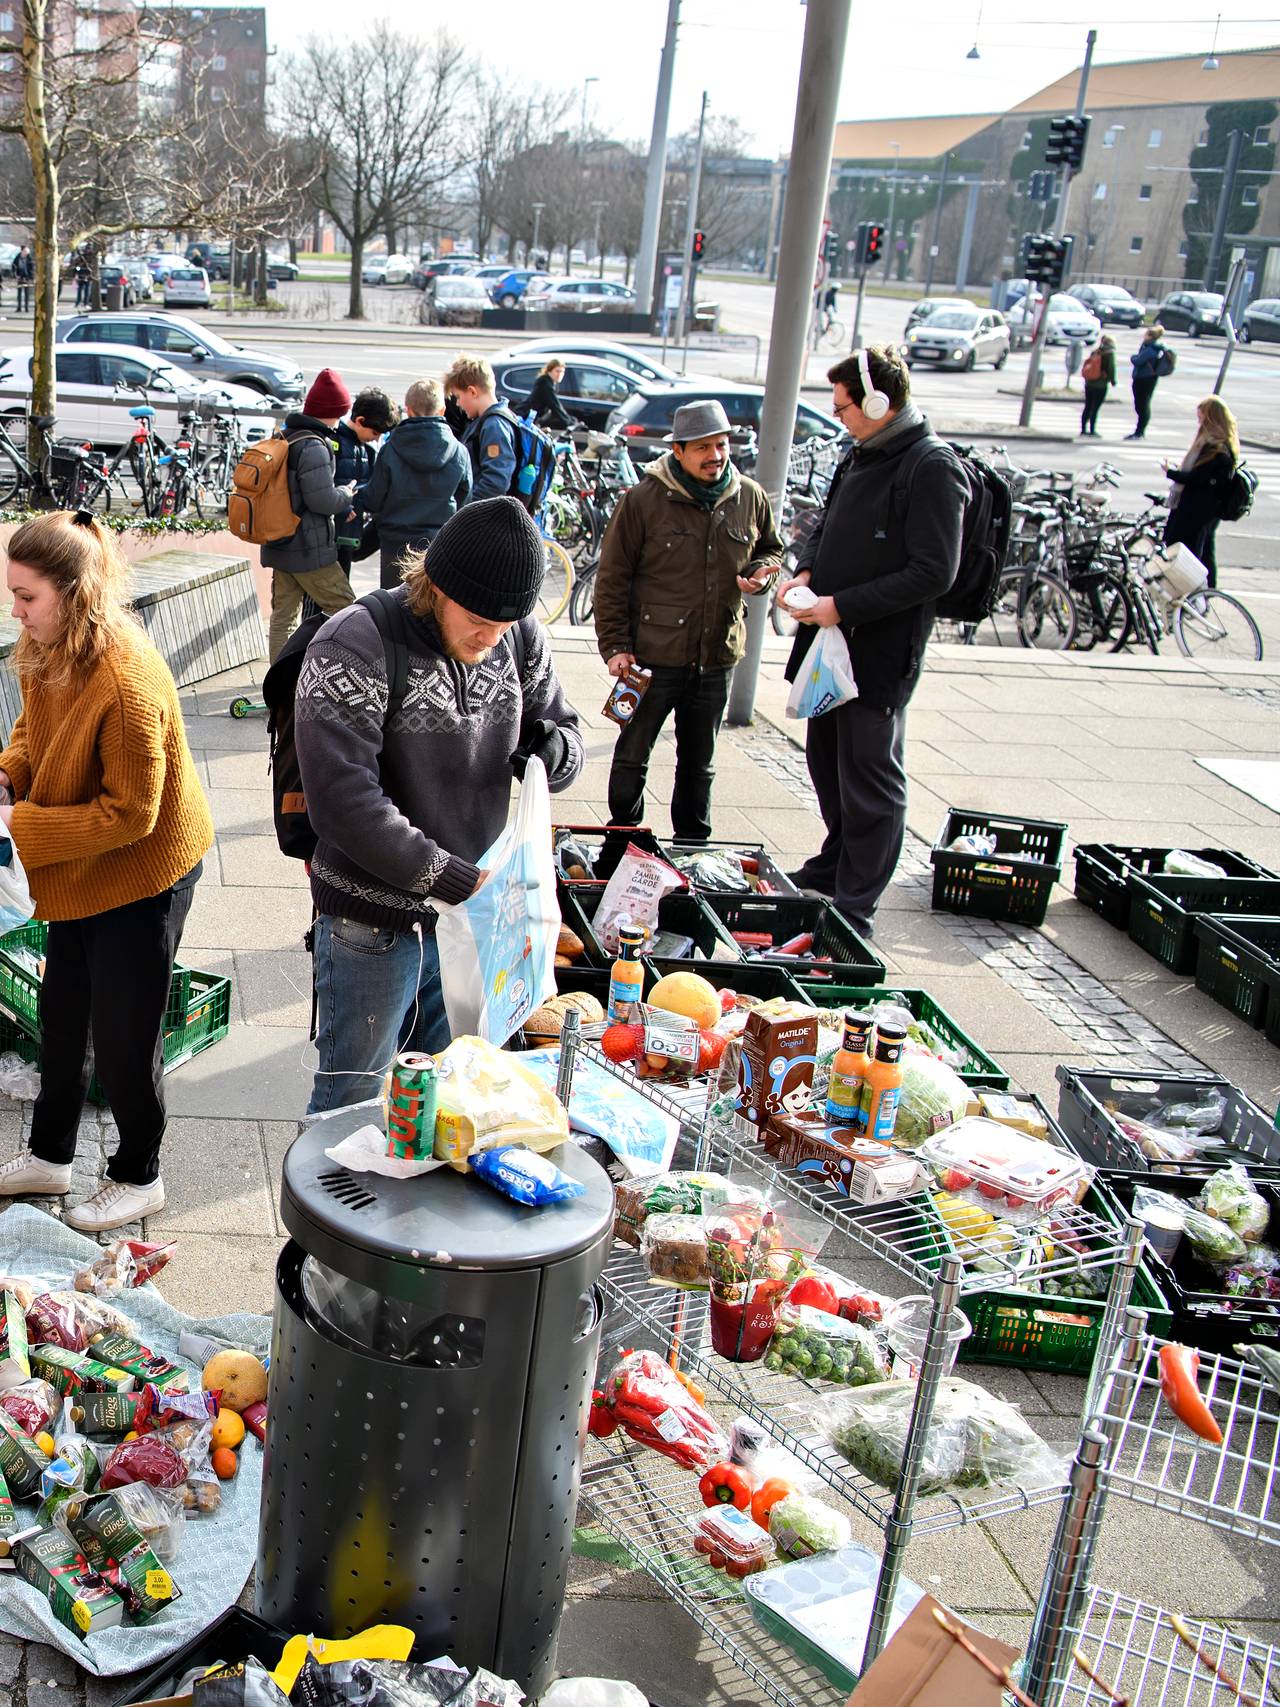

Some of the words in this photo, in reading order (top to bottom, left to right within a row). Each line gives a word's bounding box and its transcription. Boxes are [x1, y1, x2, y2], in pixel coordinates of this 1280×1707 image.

[777, 1028, 809, 1040] MATILDE
[780, 1038, 805, 1048] Original
[389, 1077, 419, 1161] CULT
[498, 1168, 537, 1193] OREO
[107, 1339, 133, 1358] Glögg
[105, 1396, 118, 1429] Glögg
[103, 1516, 127, 1537] Glögg
[37, 1540, 69, 1557] Glögg
